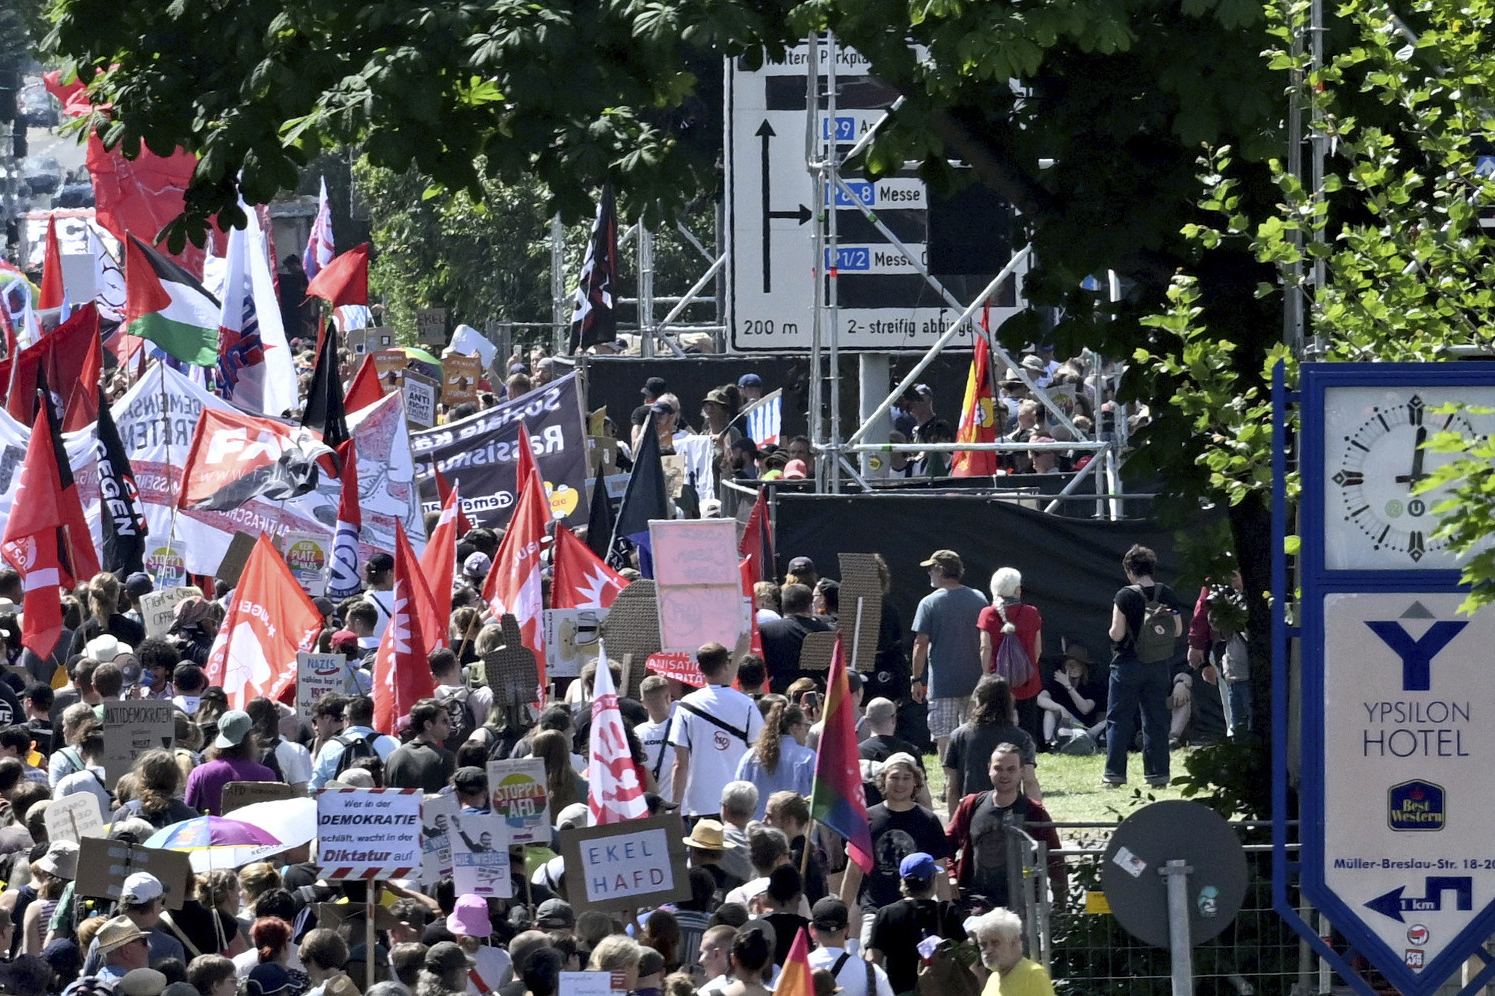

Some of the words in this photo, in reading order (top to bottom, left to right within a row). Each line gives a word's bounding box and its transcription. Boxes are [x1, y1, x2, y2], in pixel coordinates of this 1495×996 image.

[880, 186, 921, 202] Messe
[744, 320, 775, 335] 200
[782, 323, 799, 335] m
[869, 319, 916, 337] streifig
[408, 392, 430, 405] ANTI
[97, 443, 137, 539] GEGEN
[307, 657, 336, 671] NAZIS
[106, 706, 173, 725] ANTIDEMOKRATEN
[1363, 700, 1470, 724] YPSILON
[1363, 729, 1470, 758] HOTEL
[493, 782, 540, 800] STOPPT
[344, 799, 363, 809] Wer
[364, 800, 374, 809] in
[375, 799, 392, 809] der
[508, 798, 537, 819] AFD
[1402, 799, 1431, 812] Best
[321, 814, 418, 826] DEMOKRATIE
[1390, 809, 1444, 824] Western
[357, 833, 386, 843] wacht
[387, 833, 396, 842] in
[397, 833, 414, 842] der
[323, 849, 392, 862] Diktatur
[393, 849, 414, 862] auf
[589, 840, 654, 865] EKEL
[1333, 858, 1457, 870] Müller-Breslau-Str.
[594, 867, 666, 894] HAFD
[1412, 900, 1435, 910] km
